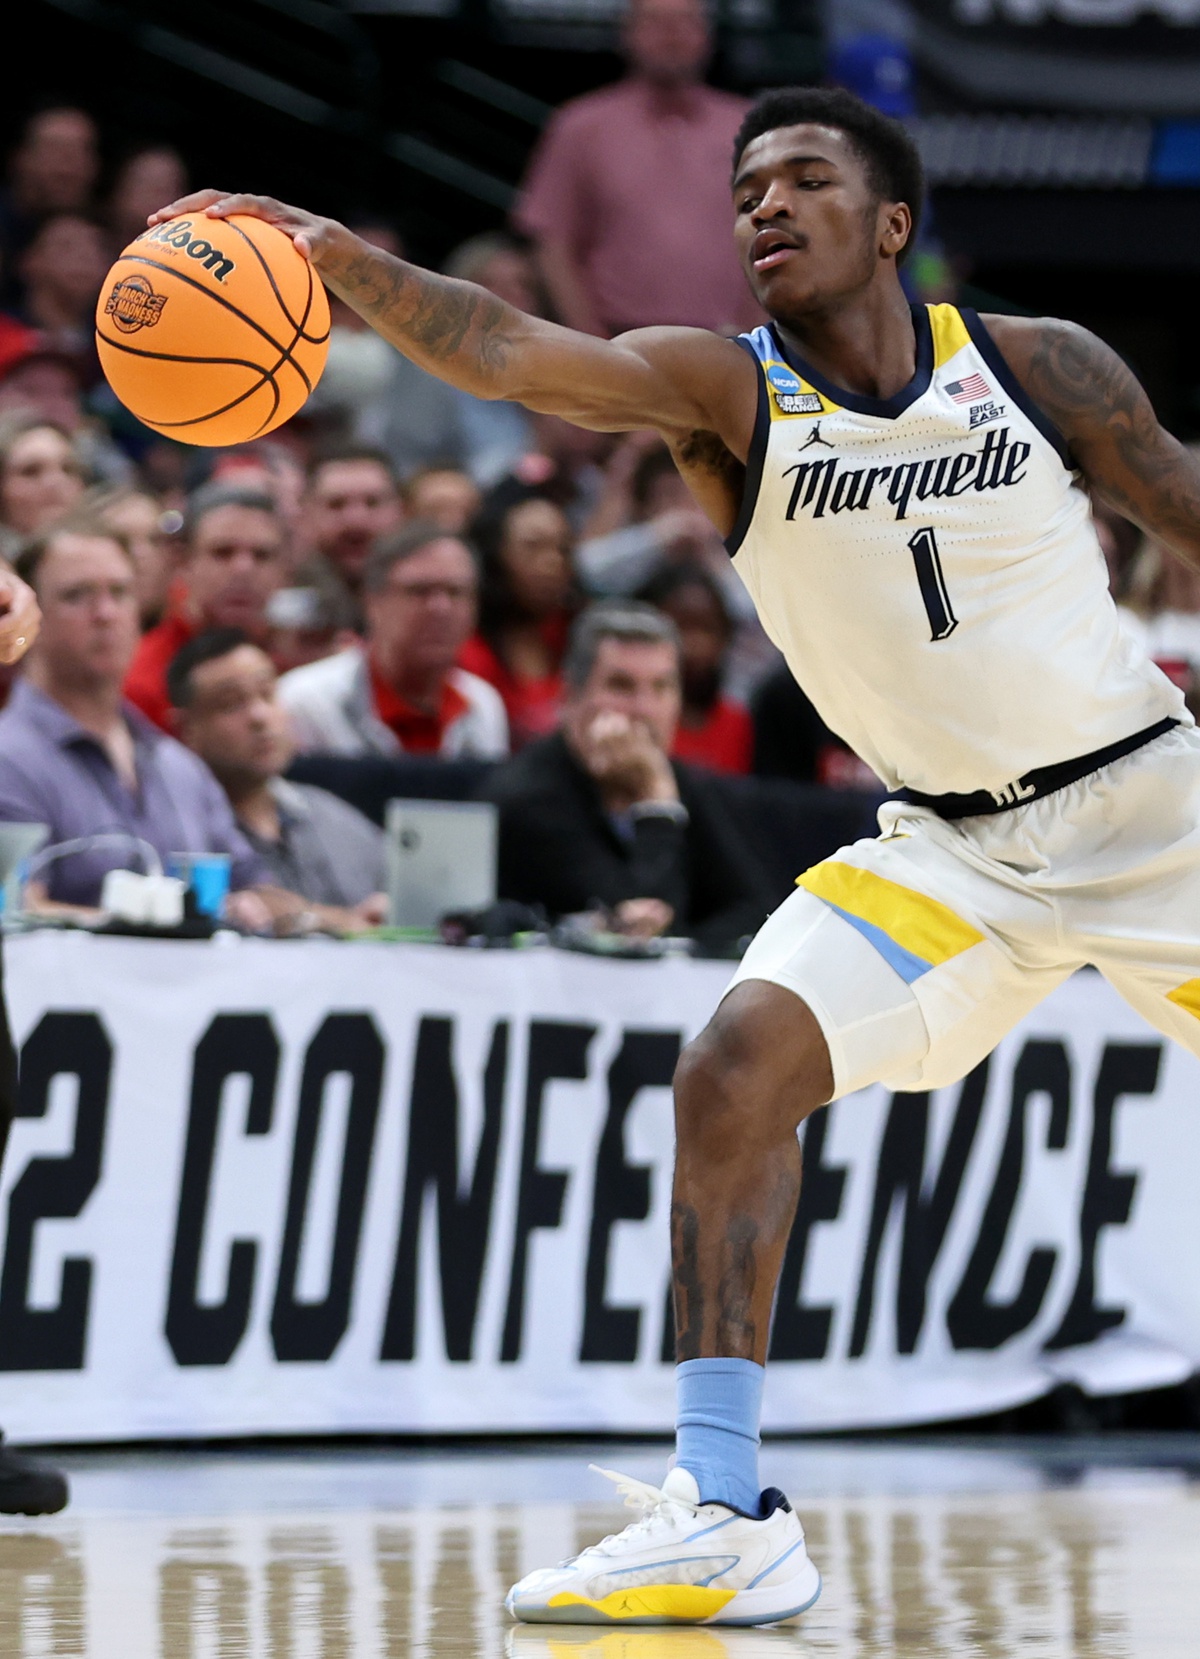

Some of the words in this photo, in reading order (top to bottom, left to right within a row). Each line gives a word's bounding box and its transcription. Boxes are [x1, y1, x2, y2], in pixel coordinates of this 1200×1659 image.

[119, 285, 149, 306] MARCH
[116, 299, 160, 323] MADNESS
[773, 377, 800, 388] NCAA
[969, 401, 994, 415] BIG
[969, 405, 1006, 426] EAST
[782, 426, 1031, 521] Marquette
[907, 526, 959, 642] 1
[0, 1011, 114, 1371] 2
[164, 1012, 1164, 1367] CONFEENCE
